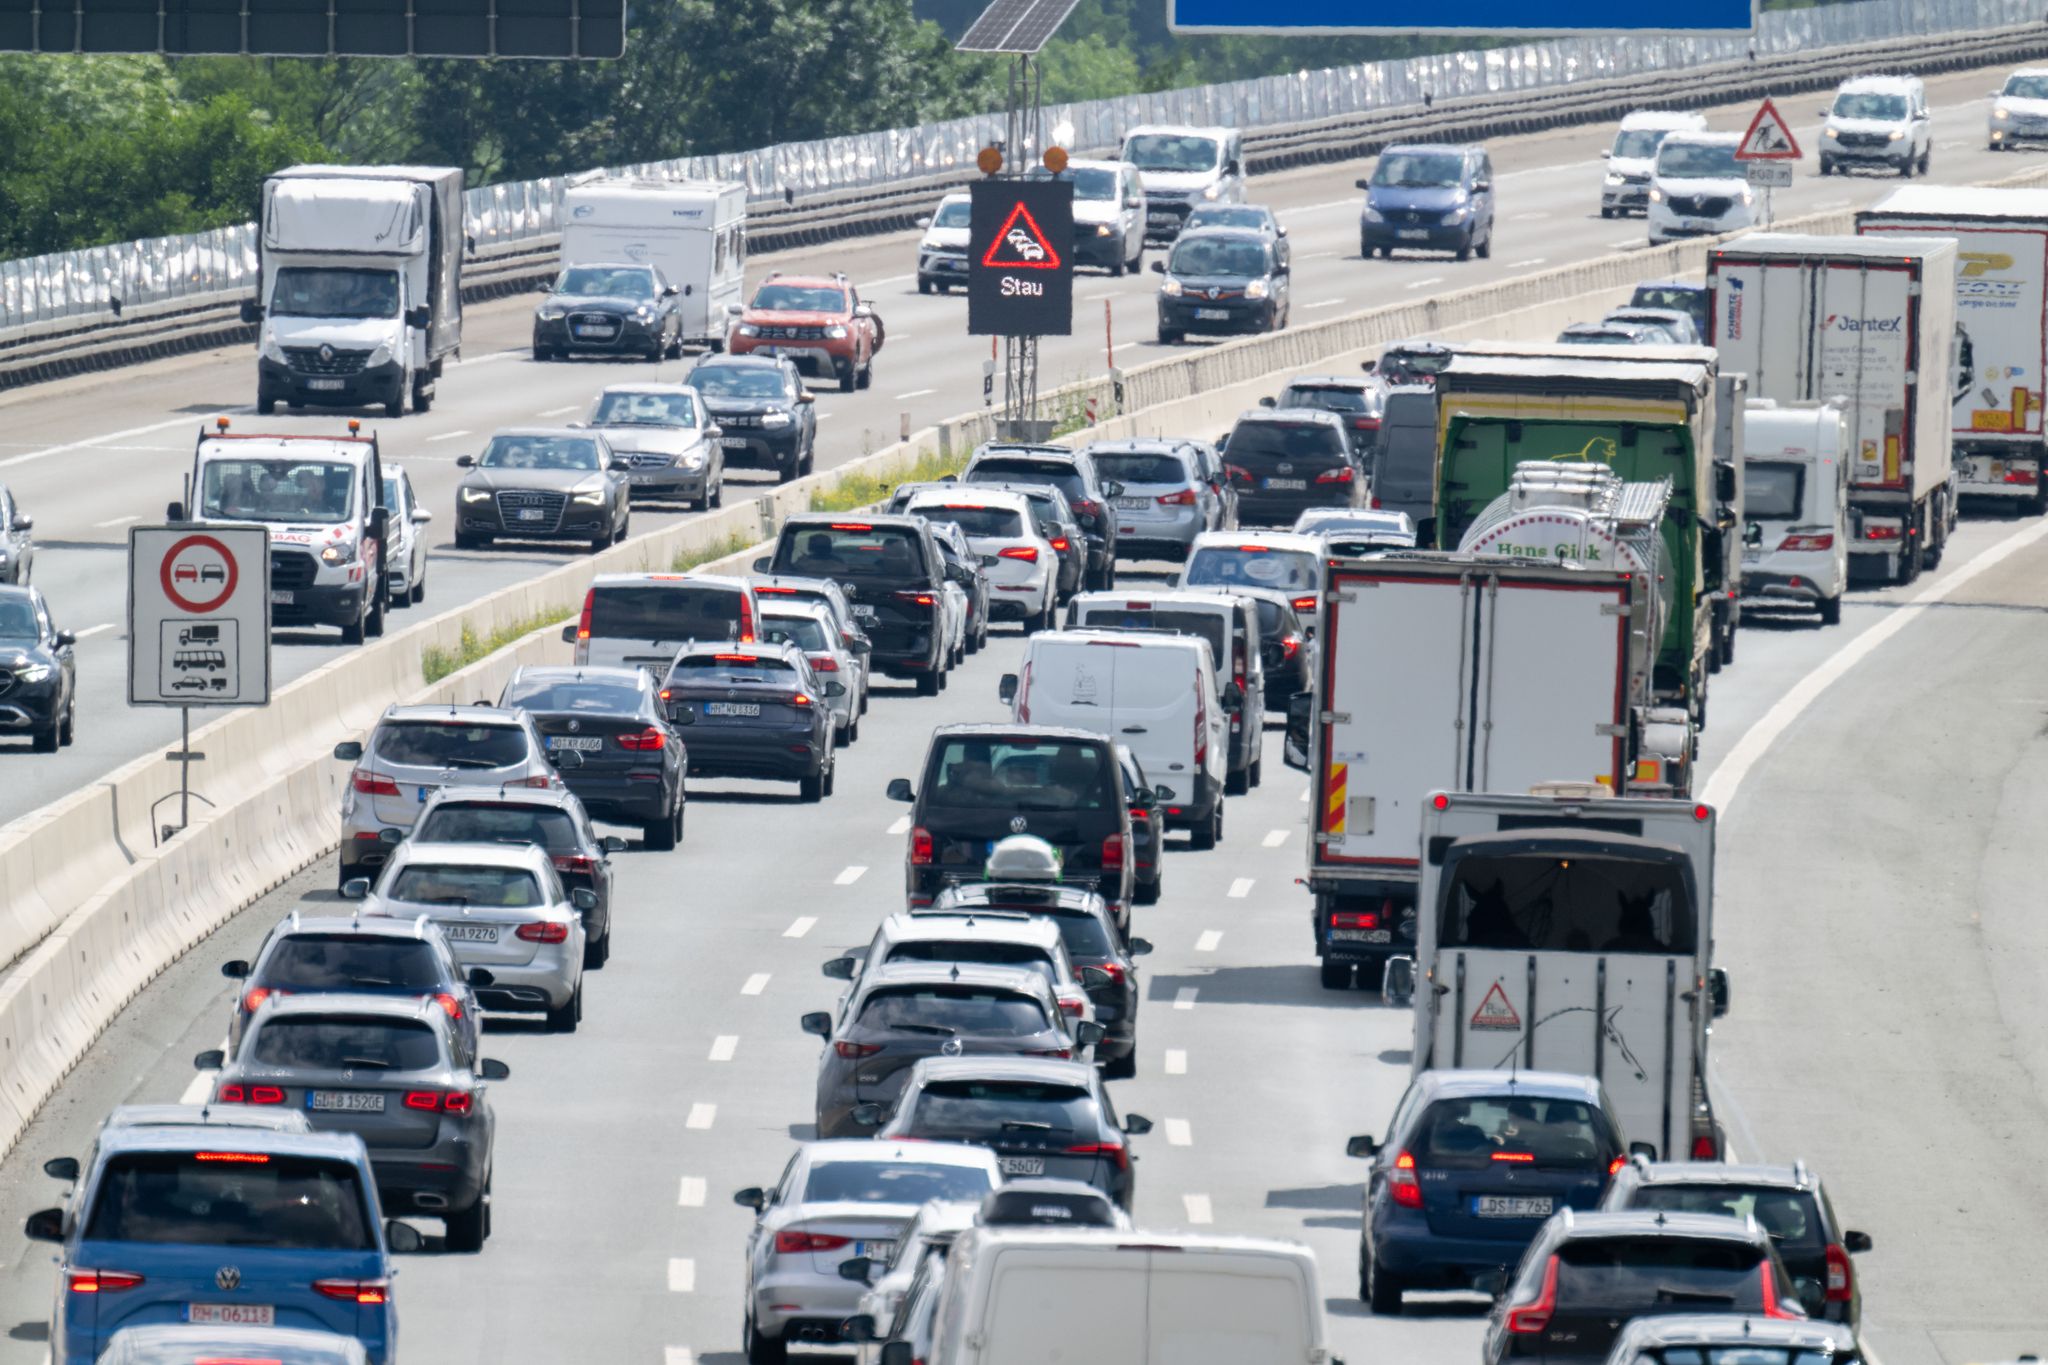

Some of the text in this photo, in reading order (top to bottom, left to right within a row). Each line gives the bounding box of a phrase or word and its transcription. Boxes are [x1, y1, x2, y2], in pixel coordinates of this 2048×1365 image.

[1001, 276, 1042, 296] Stau
[1838, 315, 1902, 332] Jantex
[270, 533, 310, 543] BAG
[1497, 543, 1548, 557] Hans
[468, 928, 496, 940] 9276
[1008, 1159, 1041, 1174] 5607
[1526, 1199, 1551, 1213] 765
